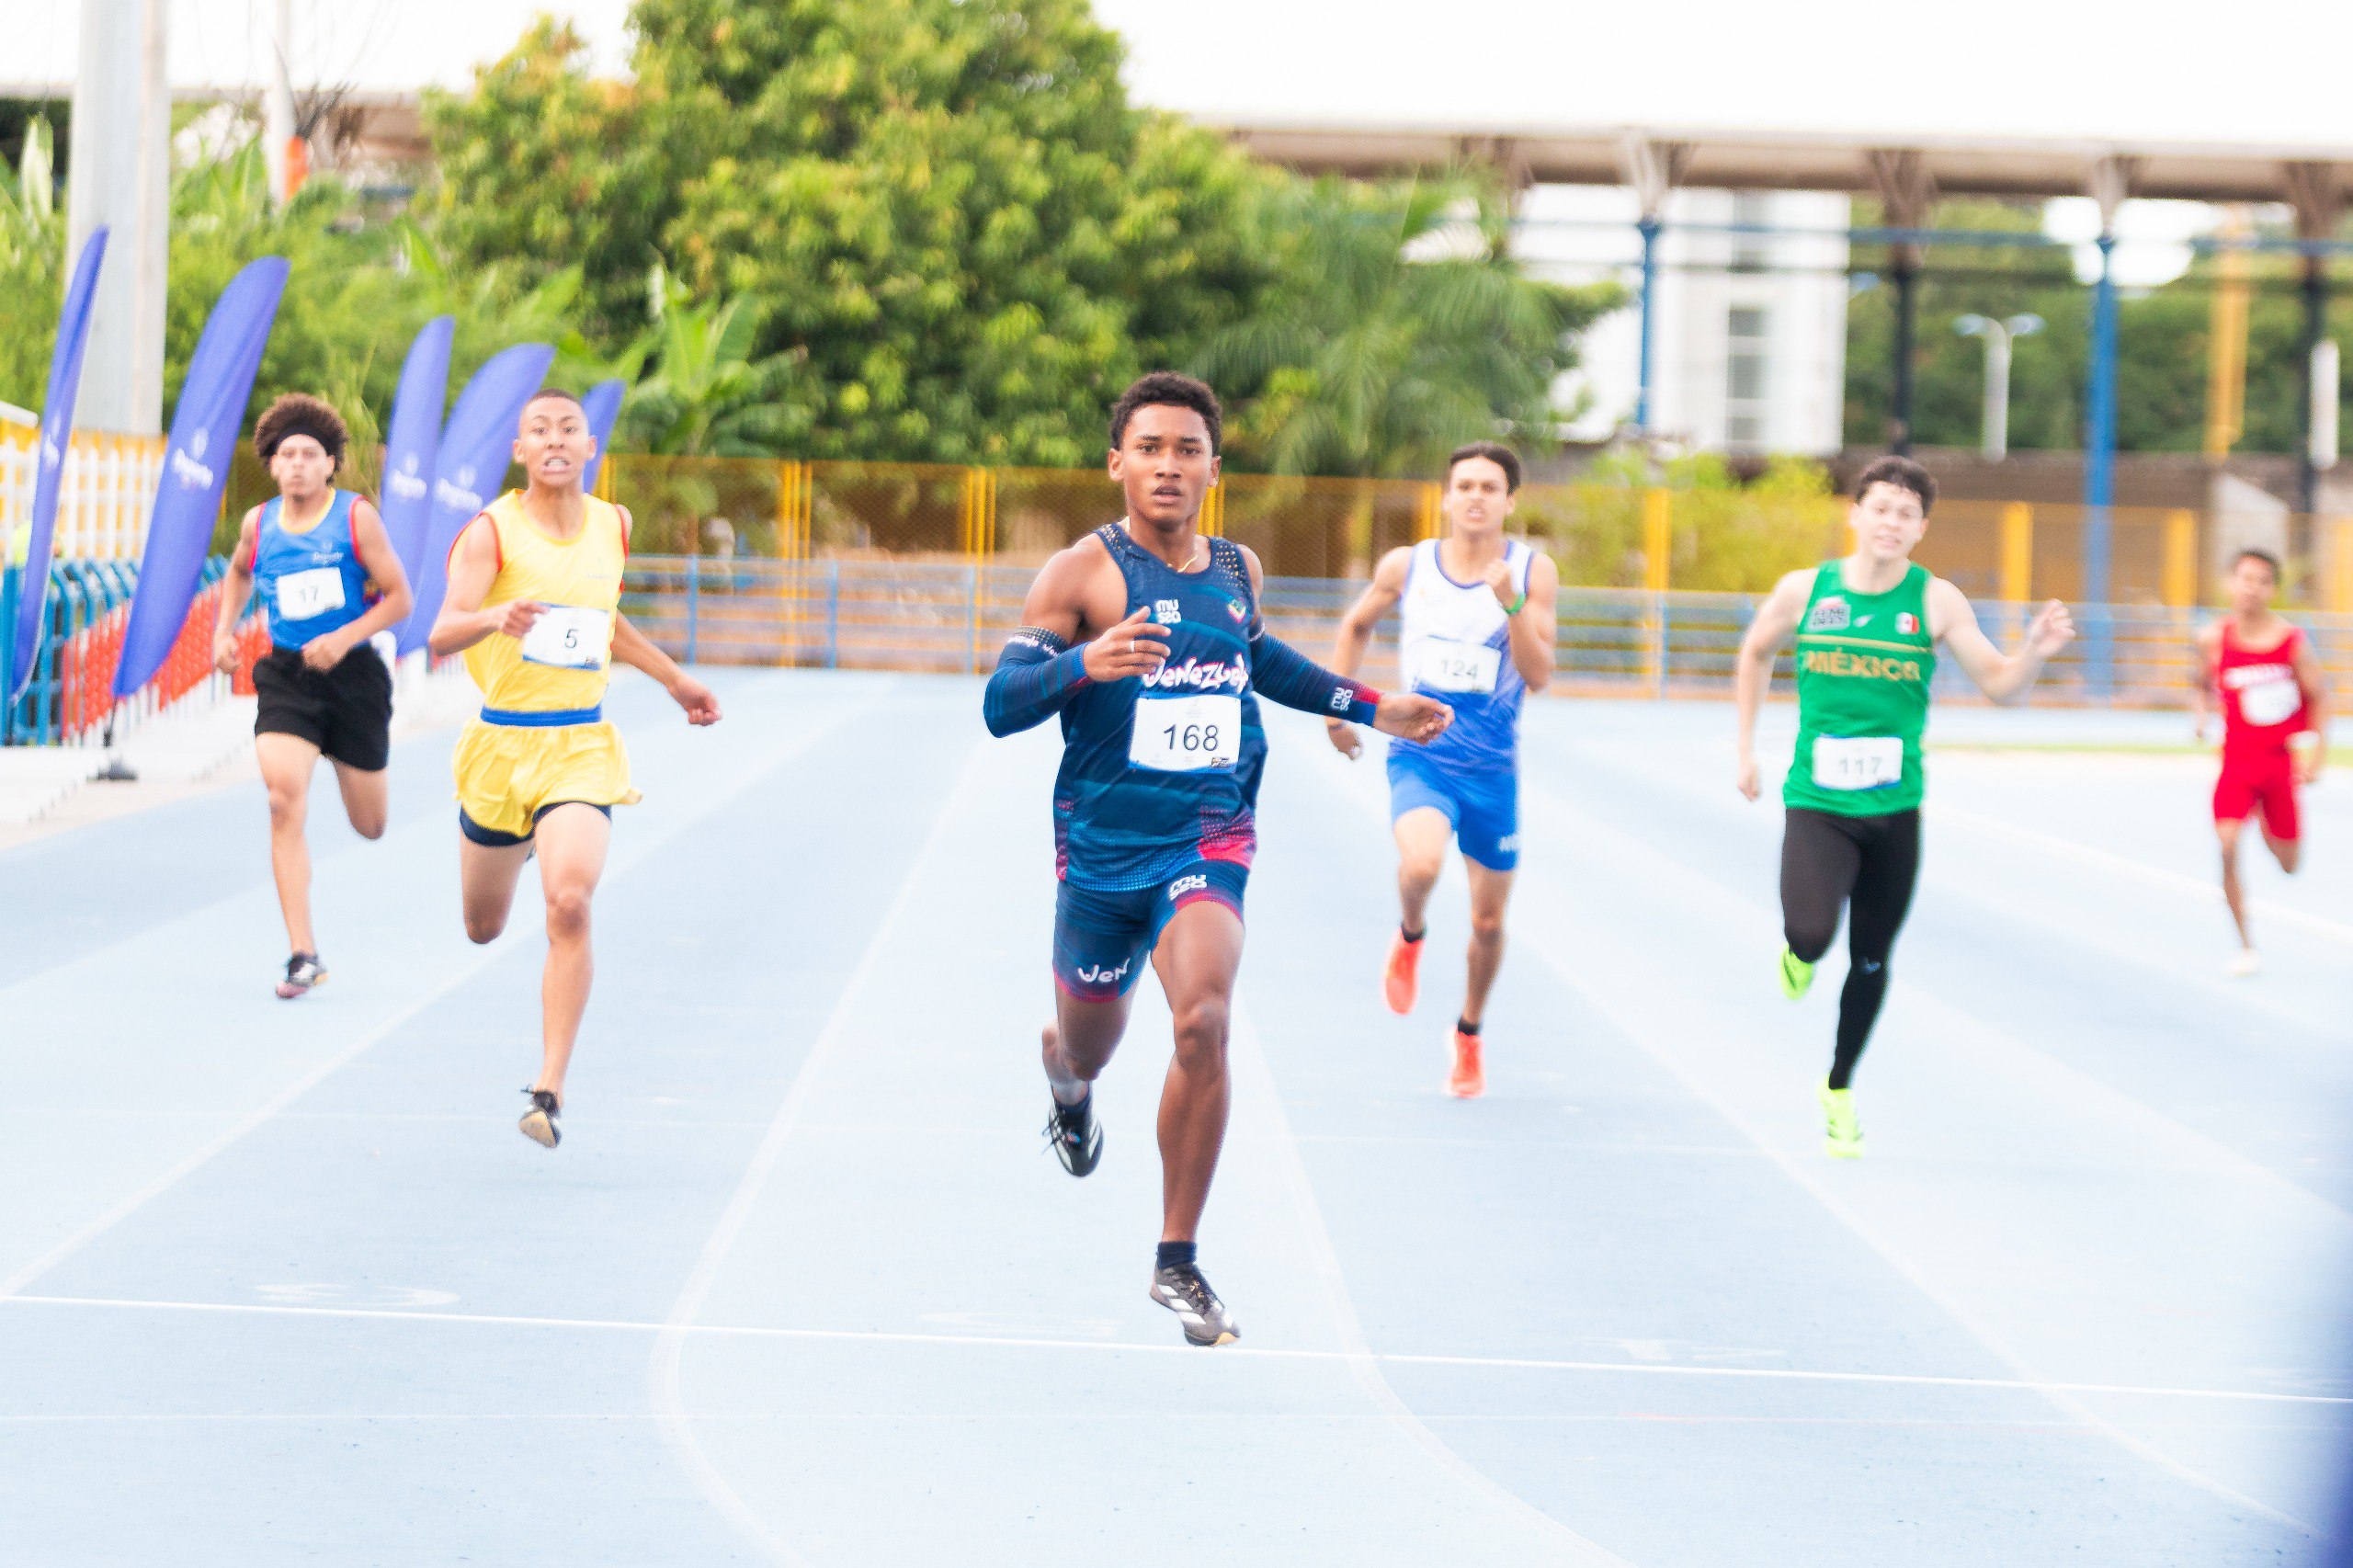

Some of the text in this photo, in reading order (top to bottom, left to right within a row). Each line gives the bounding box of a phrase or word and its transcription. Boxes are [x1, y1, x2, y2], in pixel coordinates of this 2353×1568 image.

[299, 585, 320, 602] 17
[564, 629, 580, 649] 5
[1439, 658, 1479, 680] 124
[1806, 646, 1921, 682] MÉXICO
[1163, 723, 1219, 752] 168
[1838, 756, 1884, 775] 117
